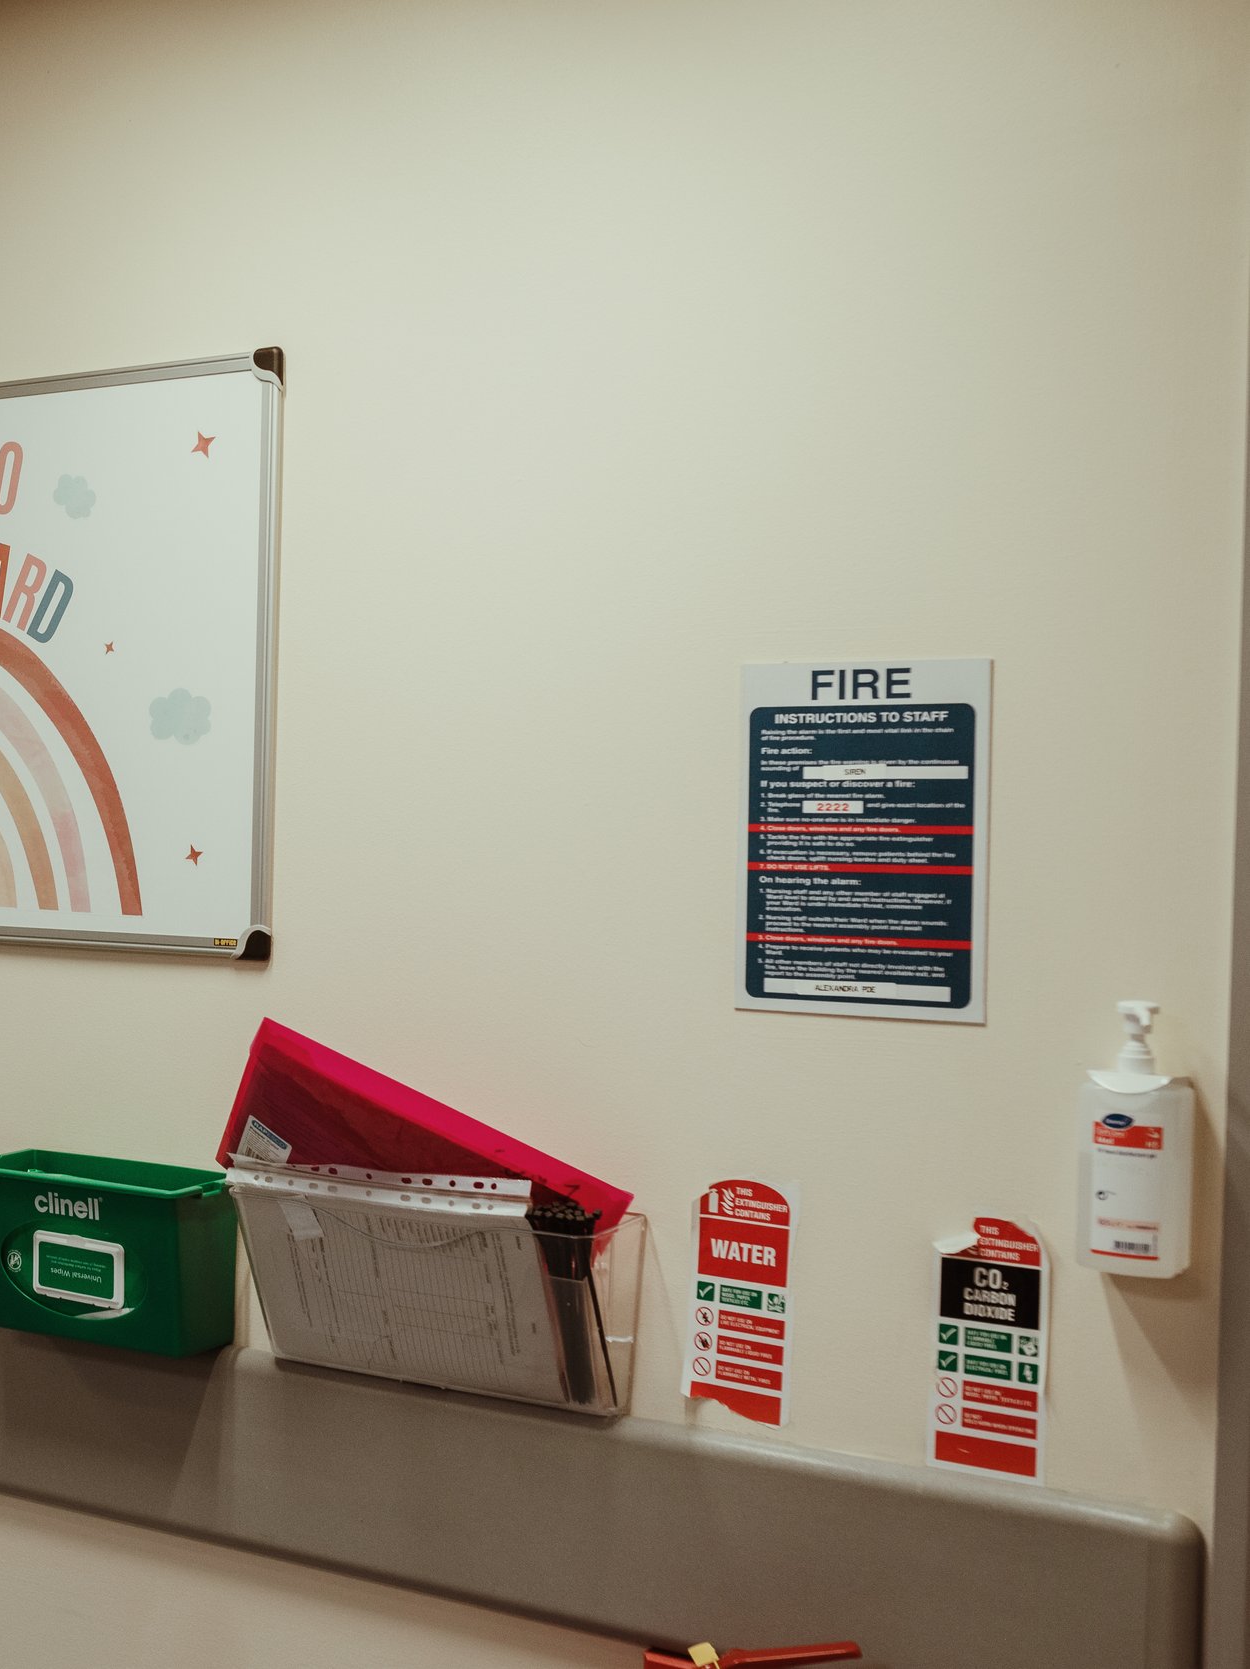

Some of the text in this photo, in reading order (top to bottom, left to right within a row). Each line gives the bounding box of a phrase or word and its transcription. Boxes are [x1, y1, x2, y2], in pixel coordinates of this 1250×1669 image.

[811, 668, 911, 699] FIRE
[775, 710, 948, 723] INSTRUCTIONS TO STAFF
[817, 802, 848, 811] 2222
[775, 876, 811, 885] hearing
[736, 1186, 753, 1196] THIS
[34, 1193, 99, 1219] clinell
[734, 1198, 788, 1213] EXTINGUISHER
[734, 1208, 771, 1221] CONTAINS
[980, 1225, 1000, 1235] THIS
[710, 1238, 776, 1267] WATER
[980, 1248, 1020, 1261] CONTAINS
[50, 1267, 102, 1284] Universal Wipes
[963, 1288, 1016, 1307] CARBON
[963, 1302, 1016, 1321] DIOXIDE
